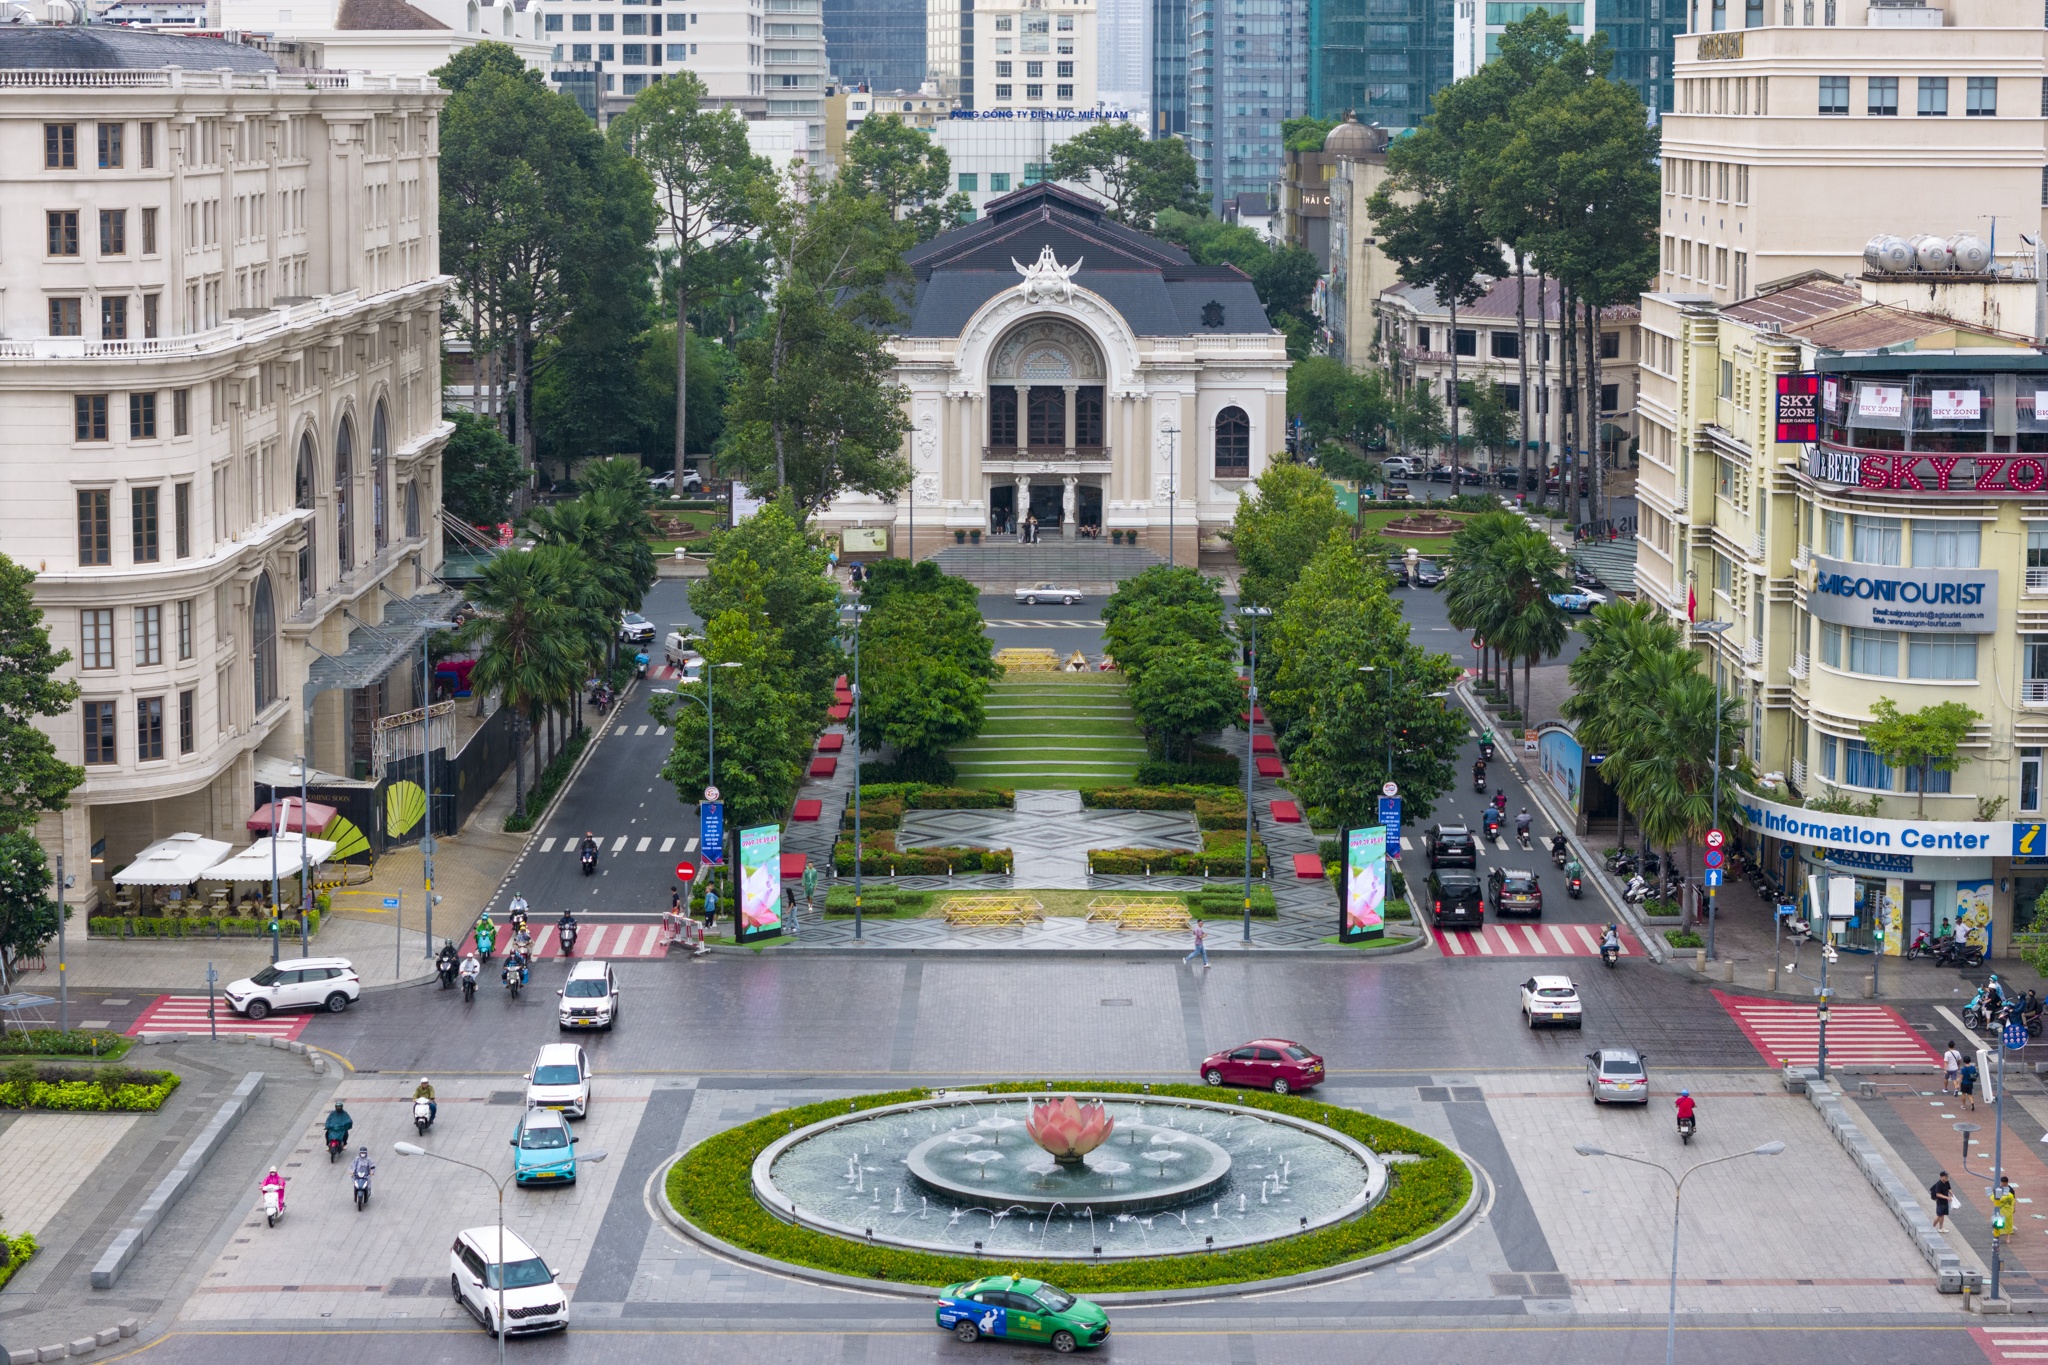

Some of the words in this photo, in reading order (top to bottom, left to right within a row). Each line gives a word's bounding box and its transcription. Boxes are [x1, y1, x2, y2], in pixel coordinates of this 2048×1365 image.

[1016, 110, 1028, 119] TY
[1105, 110, 1129, 119] NAM
[1302, 193, 1320, 205] THÁI
[1780, 395, 1815, 407] SKY
[1780, 408, 1815, 417] ZONE
[1860, 404, 1877, 412] SKY
[1878, 405, 1900, 413] ZONE
[1827, 452, 1860, 484] BEER
[1861, 455, 1960, 490] SKY
[1975, 457, 2048, 492] ZO
[1818, 570, 1986, 605] SAIGONTOURIST
[332, 794, 350, 802] SOON
[1766, 810, 1890, 846] Information
[1901, 828, 1990, 849] Center
